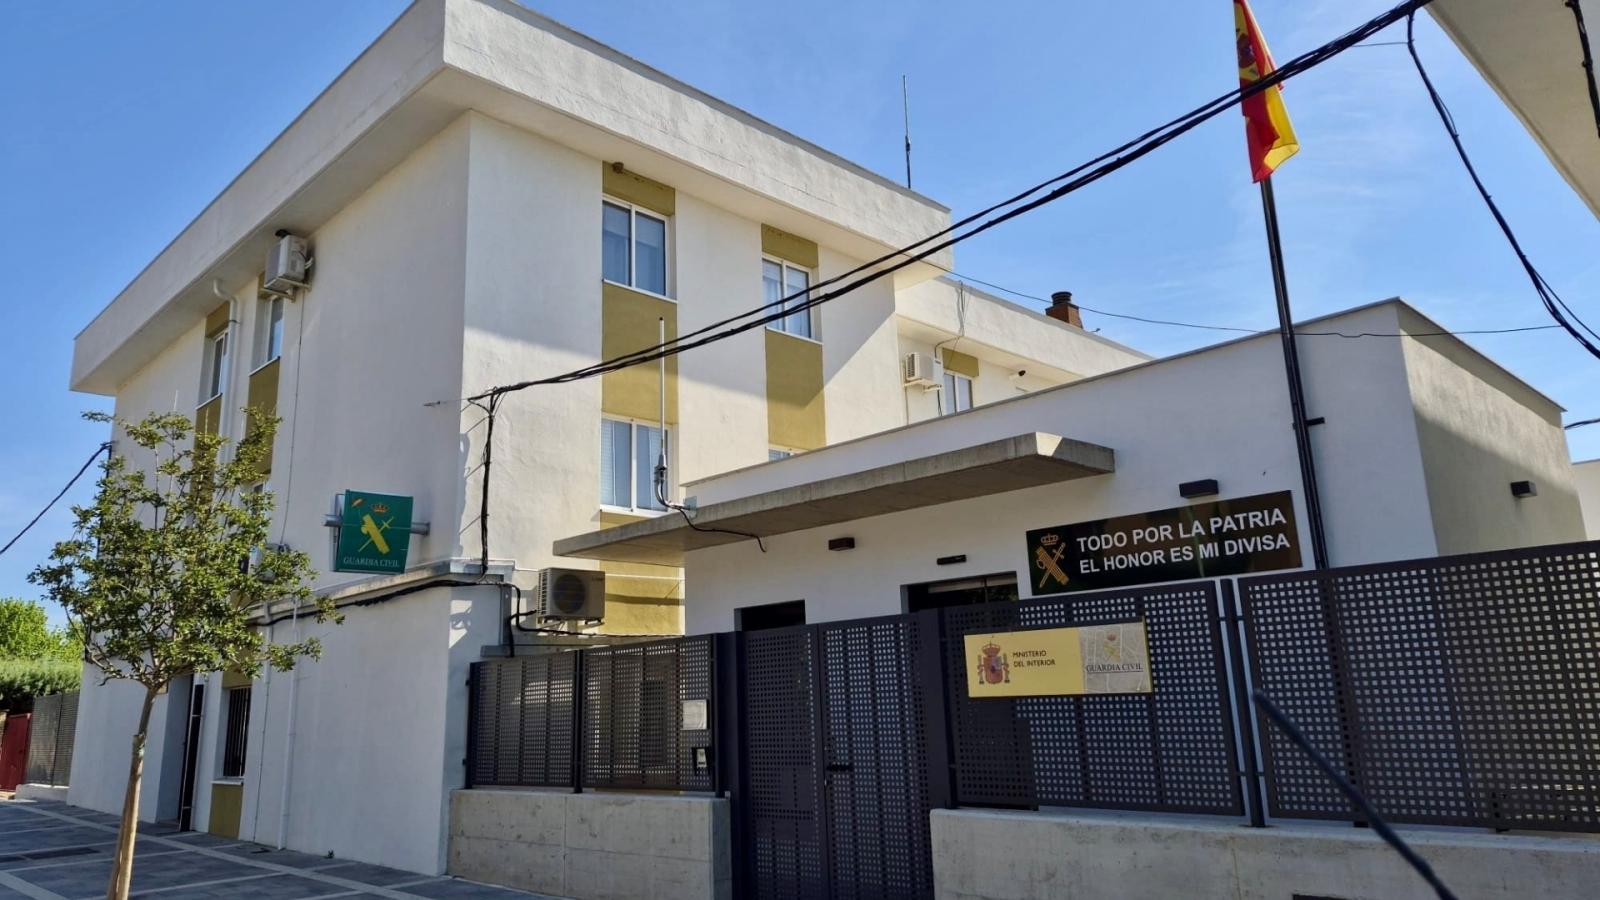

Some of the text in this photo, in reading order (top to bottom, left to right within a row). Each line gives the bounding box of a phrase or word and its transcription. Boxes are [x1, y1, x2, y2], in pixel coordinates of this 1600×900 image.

[1076, 507, 1287, 553] TODO POR LA PATRIA
[1079, 532, 1291, 574] EL HONOR ES MI DIVISA
[343, 556, 399, 568] GUARDIA CIVIL
[1013, 658, 1056, 668] DEL INTERIOR
[1086, 663, 1143, 672] GUARDIA CIVIL
